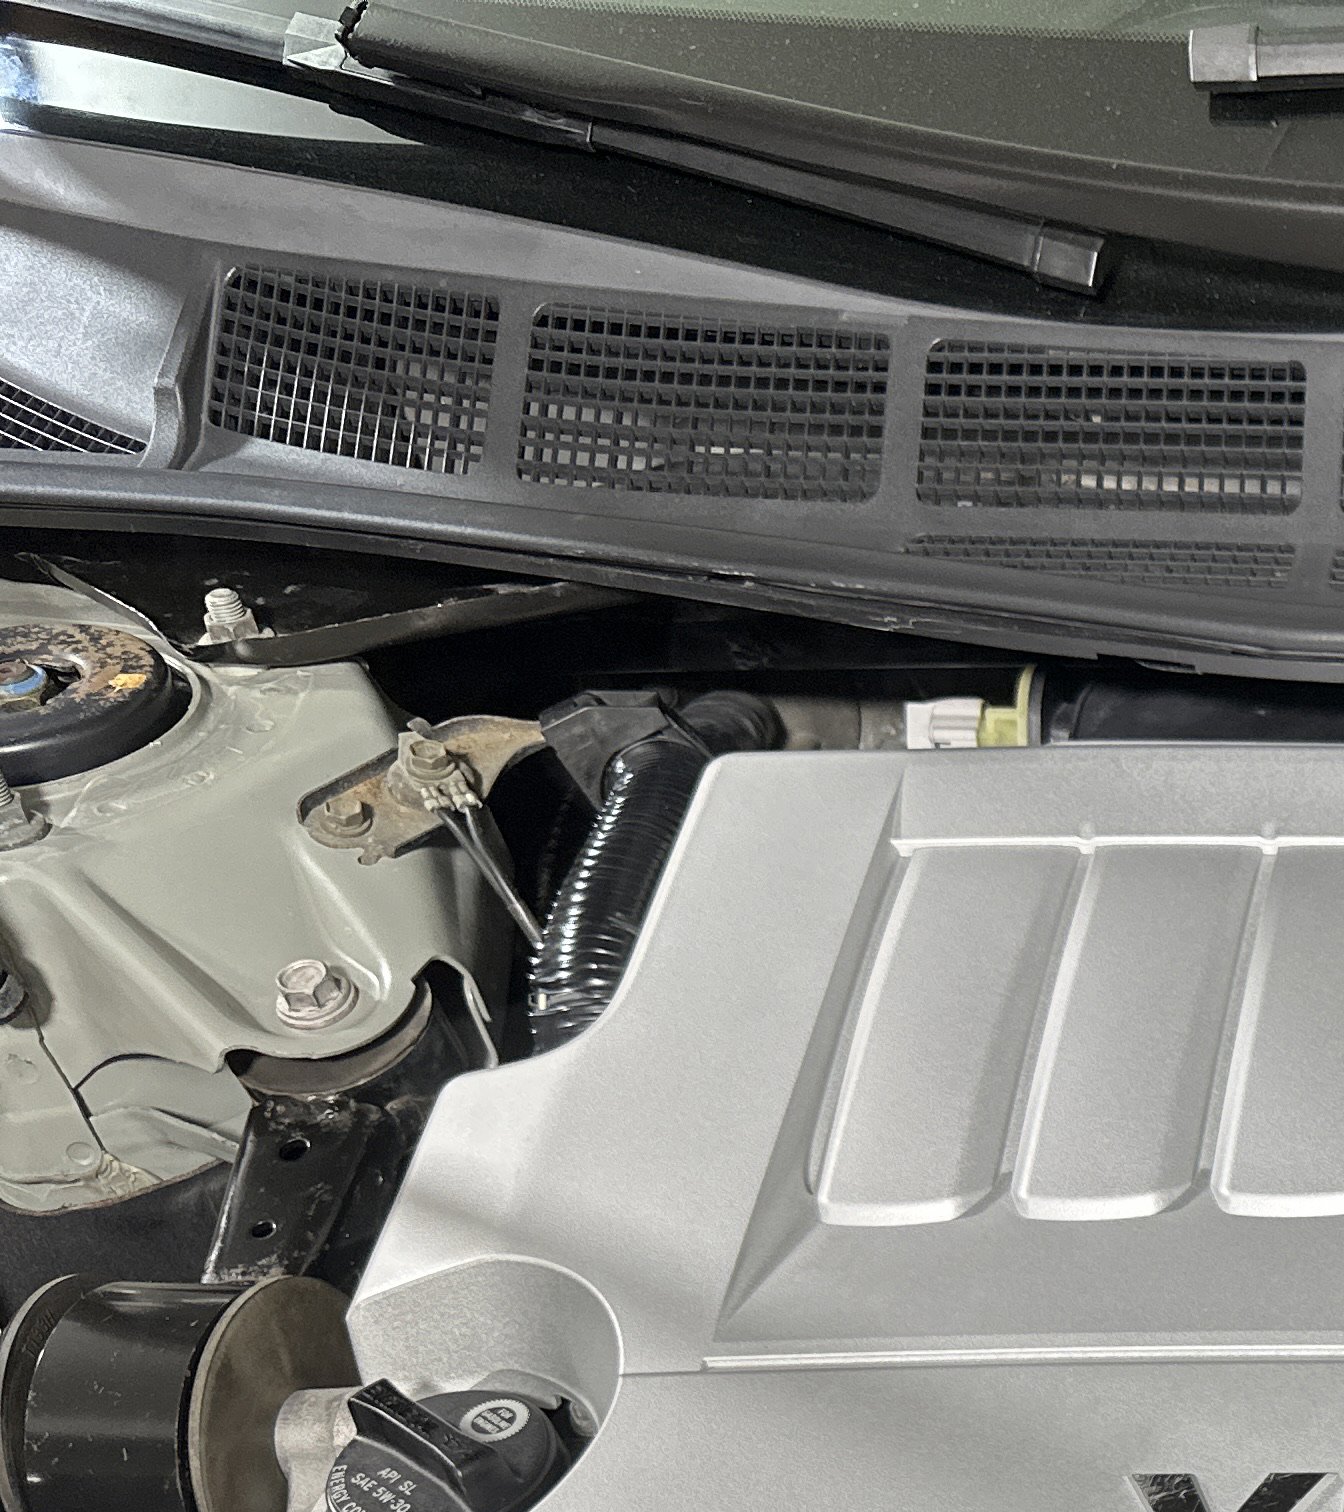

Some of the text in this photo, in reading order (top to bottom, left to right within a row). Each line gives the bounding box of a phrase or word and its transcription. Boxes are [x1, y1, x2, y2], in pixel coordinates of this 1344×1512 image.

[330, 1464, 351, 1503] ENERGY
[351, 1472, 378, 1491] SAE
[377, 1467, 417, 1496] API SL
